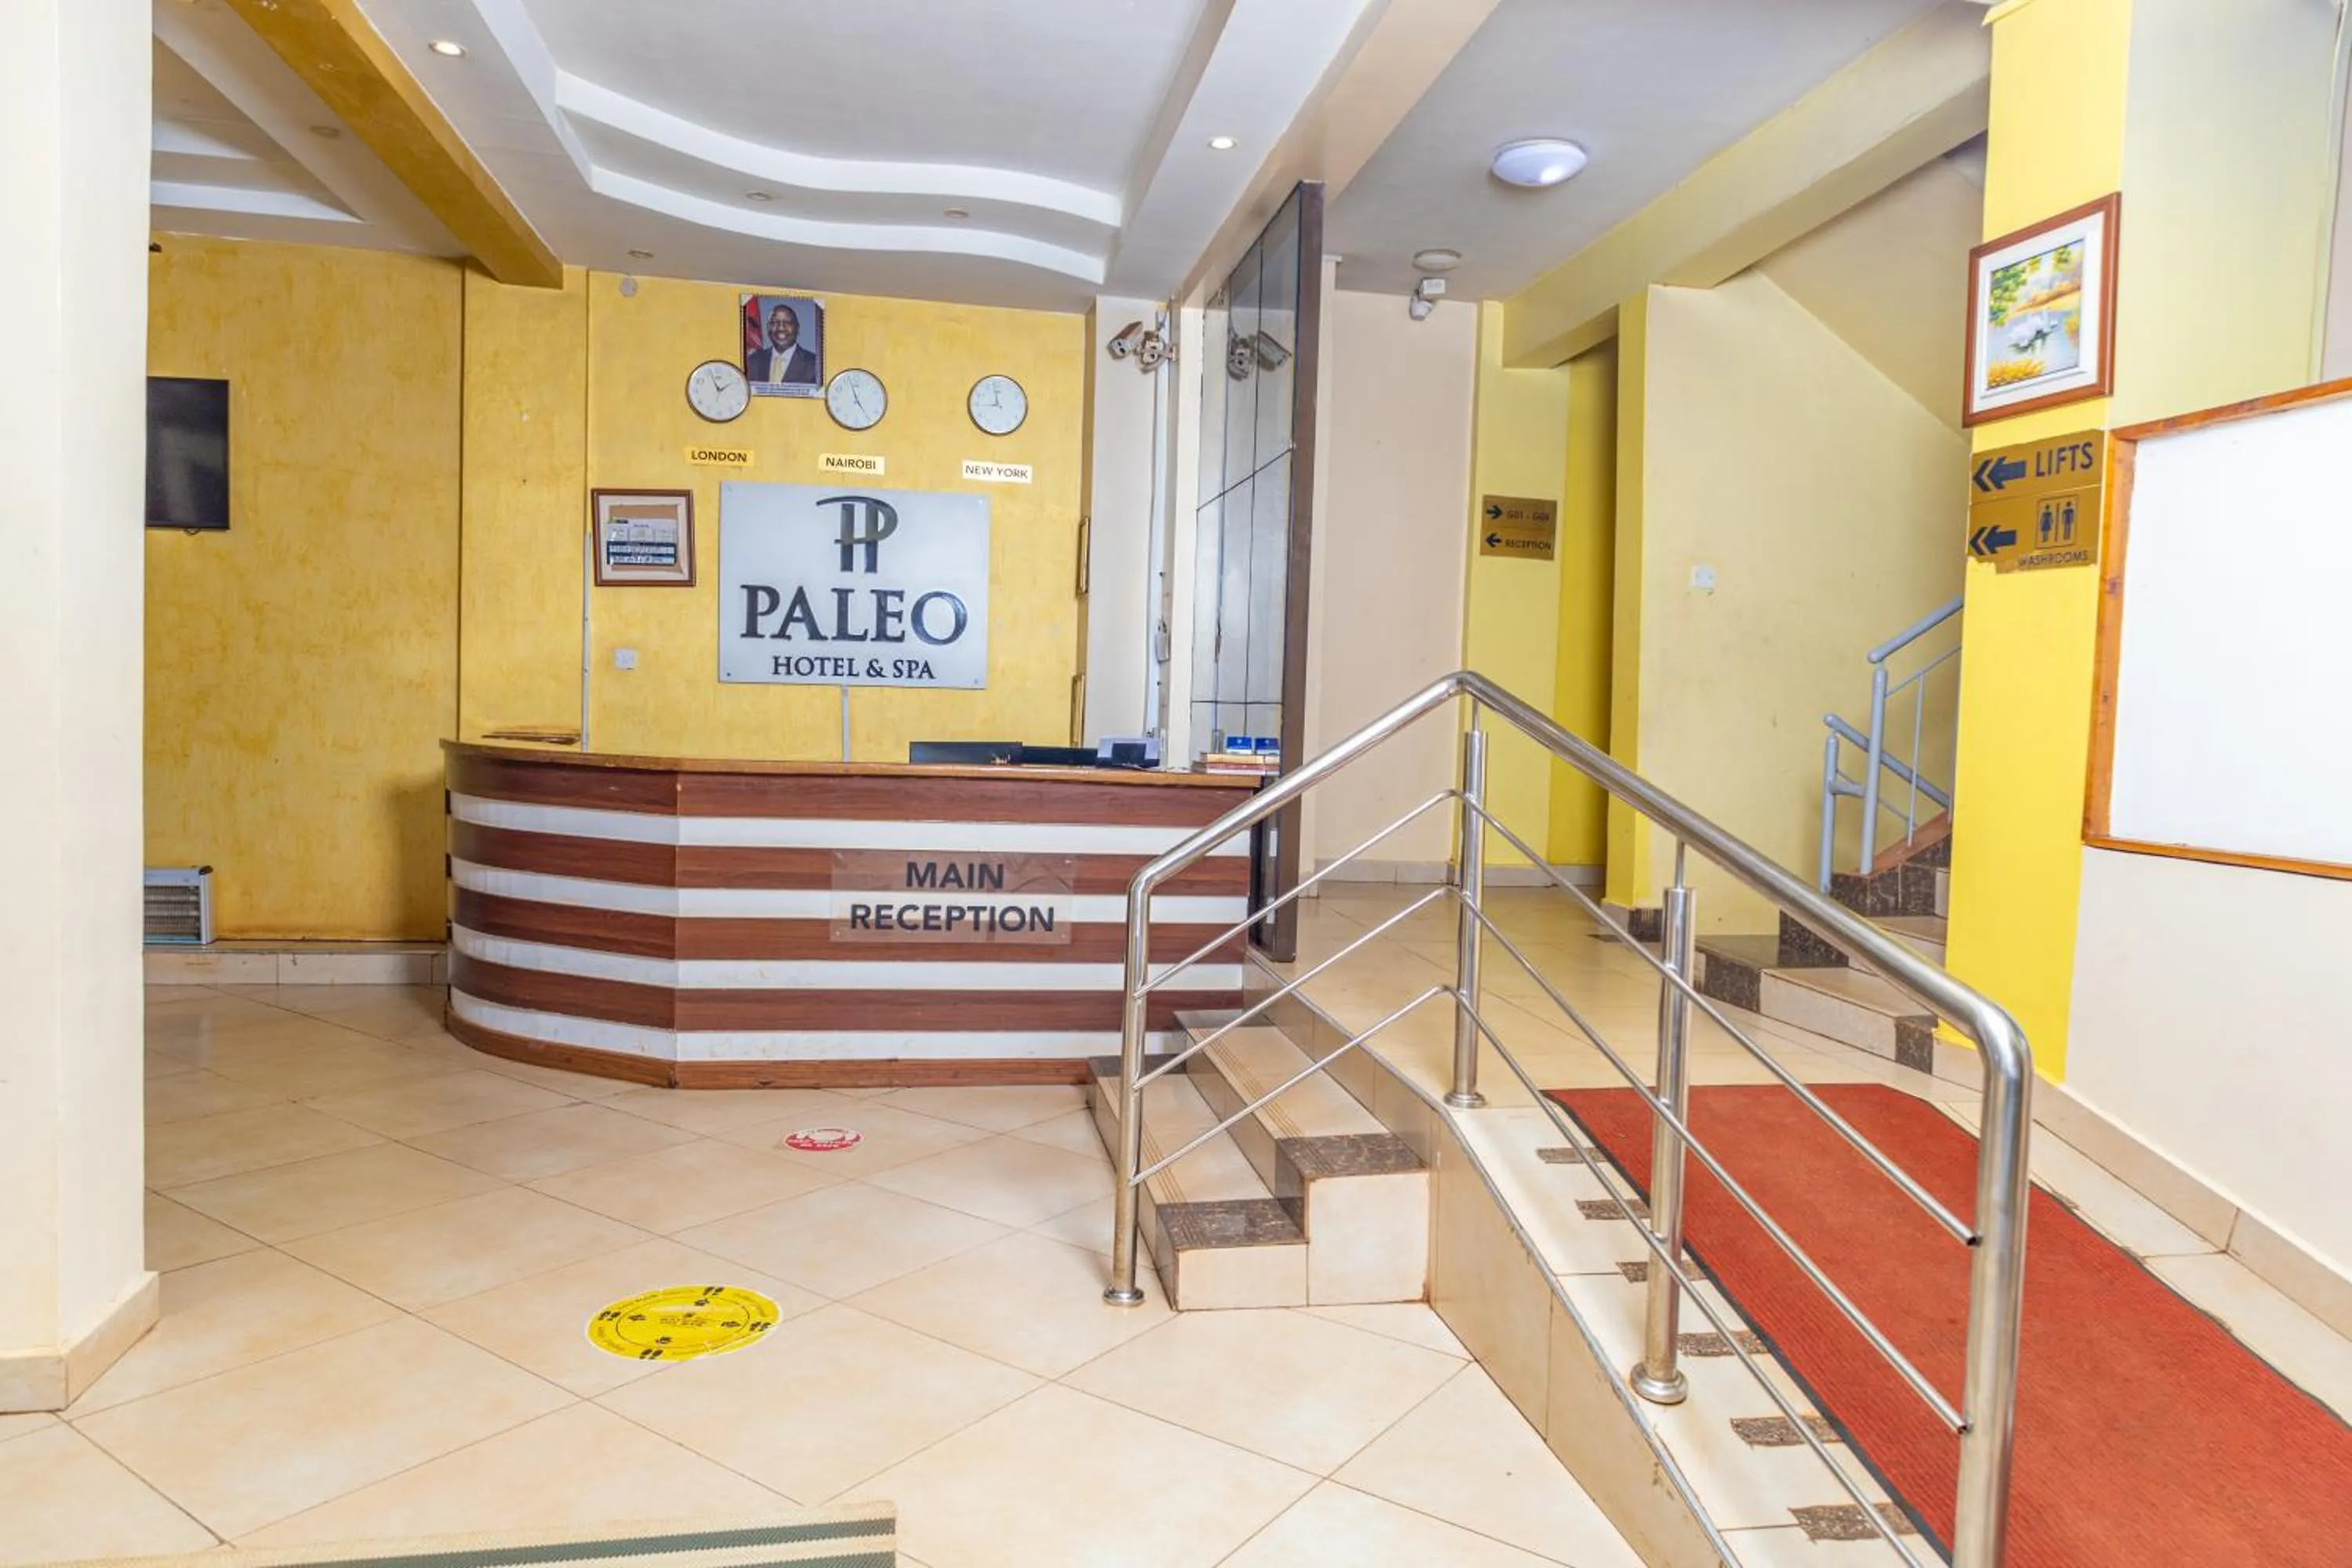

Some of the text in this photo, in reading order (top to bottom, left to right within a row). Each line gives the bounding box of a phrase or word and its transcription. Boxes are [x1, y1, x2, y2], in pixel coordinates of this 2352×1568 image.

[691, 450, 747, 463] LONDON
[825, 456, 877, 470] NAIROBI
[2035, 441, 2094, 477] LIFTS
[965, 464, 1029, 479] NEW YORK
[2019, 550, 2088, 566] WASHROOMS
[740, 584, 967, 646] PALEO
[771, 655, 936, 680] HOTEL & SPA
[906, 861, 1004, 889] MAIN
[851, 903, 1054, 932] RECEPTION
